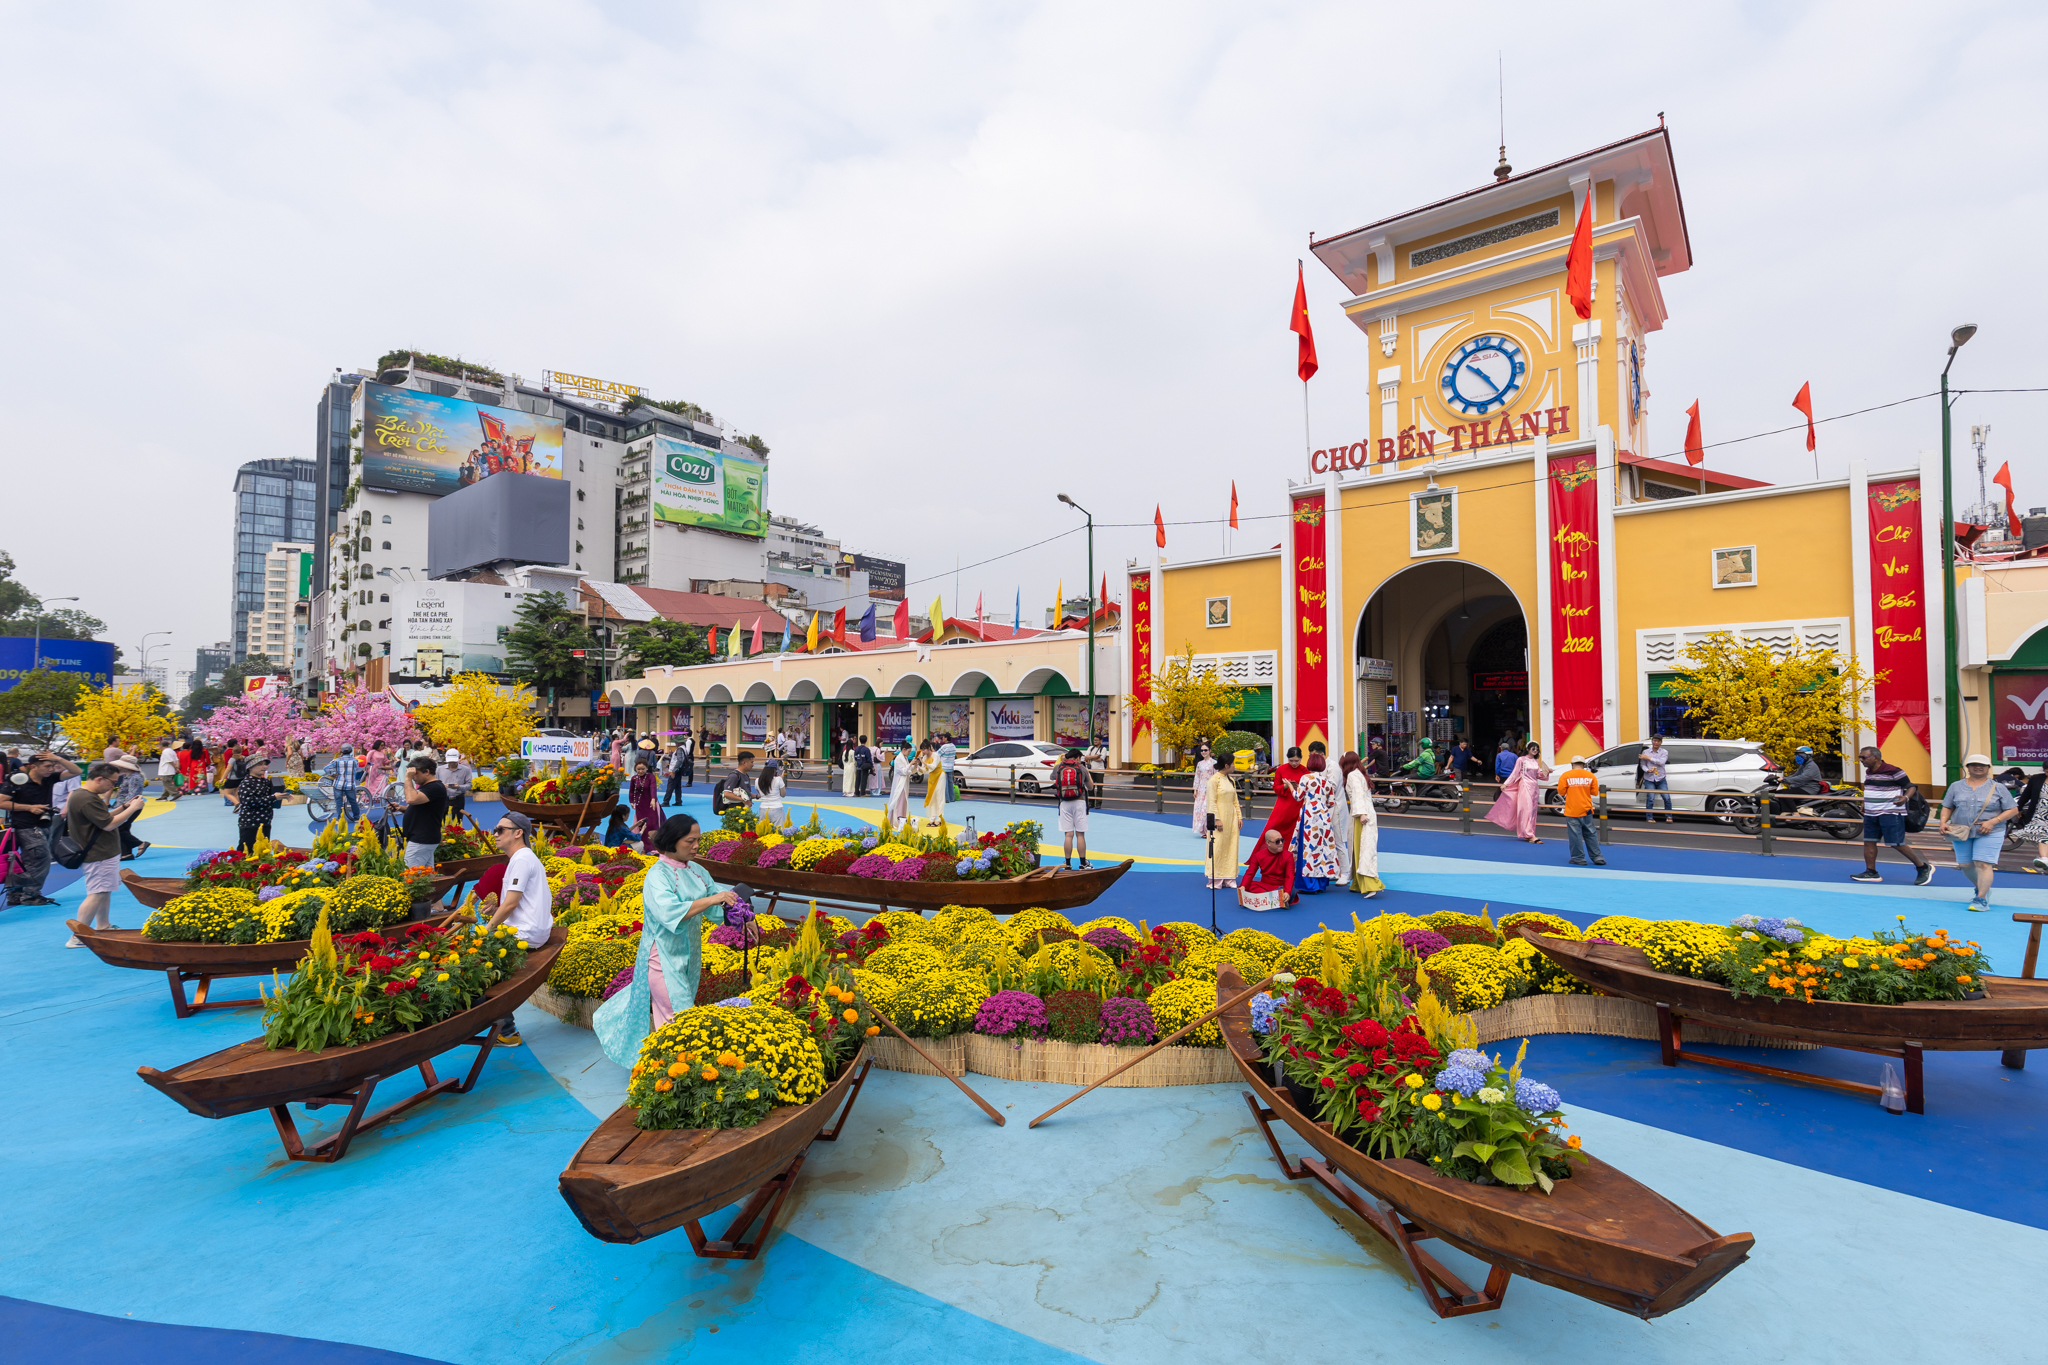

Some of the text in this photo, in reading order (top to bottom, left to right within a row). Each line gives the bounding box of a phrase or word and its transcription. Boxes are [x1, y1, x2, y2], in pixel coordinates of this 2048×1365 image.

[1473, 336, 1491, 350] 12
[1513, 361, 1525, 374] 3
[554, 372, 638, 396] SILVERLAND
[1441, 375, 1453, 387] 9
[577, 390, 617, 402] BEN THANH
[1477, 403, 1488, 414] 6
[375, 415, 450, 439] Báu Vật
[375, 429, 447, 454] Trời Cho
[1311, 406, 1571, 474] CHỢ BẾN THÀNH
[670, 457, 710, 481] Cozy
[663, 482, 682, 491] THƠM
[683, 486, 697, 494] ĐẬM
[705, 490, 717, 498] TRÀ
[672, 491, 687, 499] HÒA
[687, 494, 702, 502] NHỊP
[702, 496, 719, 505] SỐNG
[727, 487, 738, 500] BỘT
[727, 500, 750, 515] MATCHA
[1553, 521, 1598, 558] Happy
[1876, 525, 1913, 543] Chợ
[1299, 556, 1325, 572] Chúc
[1882, 556, 1909, 577] Vui
[416, 601, 445, 609] Legend
[1299, 585, 1327, 609] Mừng
[1879, 590, 1916, 610] Bến
[1561, 635, 1594, 653] 2026
[1875, 625, 1922, 649] Thành
[1304, 646, 1322, 670] Mới
[744, 709, 762, 726] Vikki
[878, 706, 902, 725] Vikki
[991, 703, 1020, 725] Vikki
[2007, 723, 2035, 731] Ngân
[532, 744, 556, 753] KHANG
[573, 741, 589, 757] 2026
[1566, 777, 1593, 786] LUNACY
